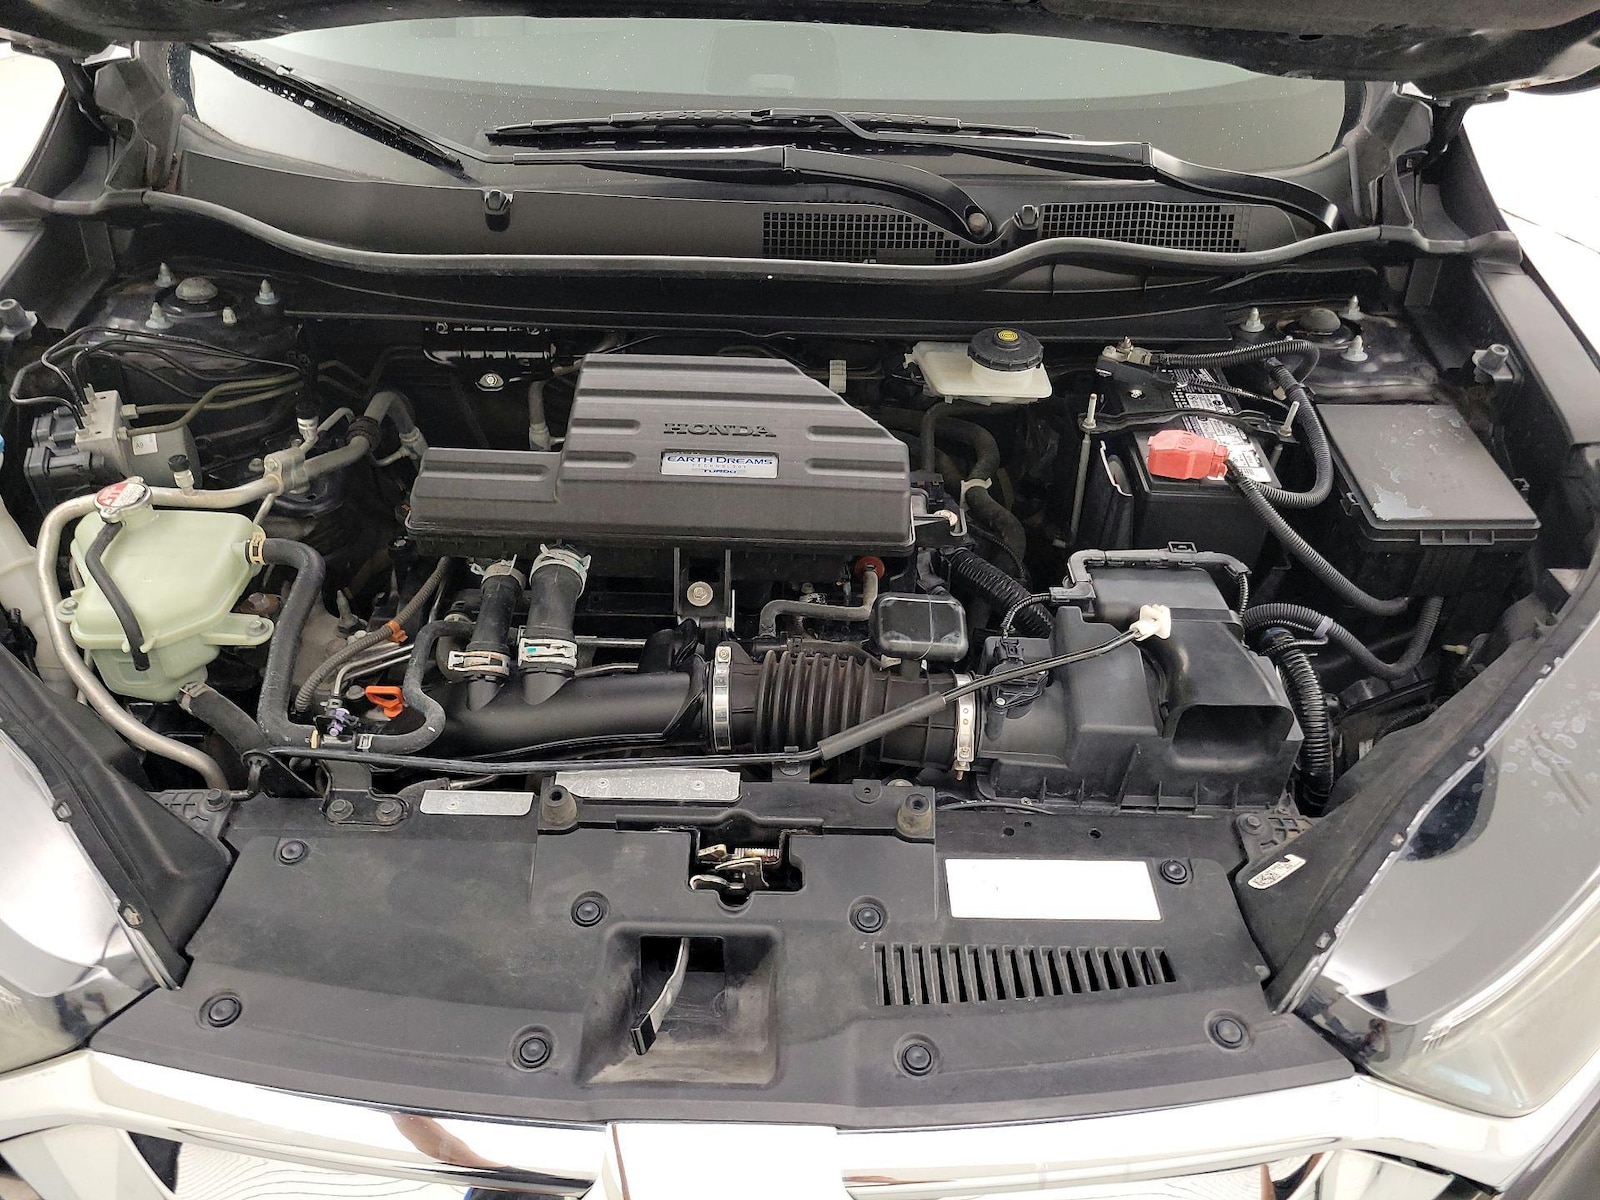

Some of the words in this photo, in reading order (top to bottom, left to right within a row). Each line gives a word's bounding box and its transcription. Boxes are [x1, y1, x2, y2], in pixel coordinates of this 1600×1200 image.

[663, 423, 777, 437] HONDA
[667, 455, 713, 464] EARTH
[716, 456, 773, 465] DREAMS
